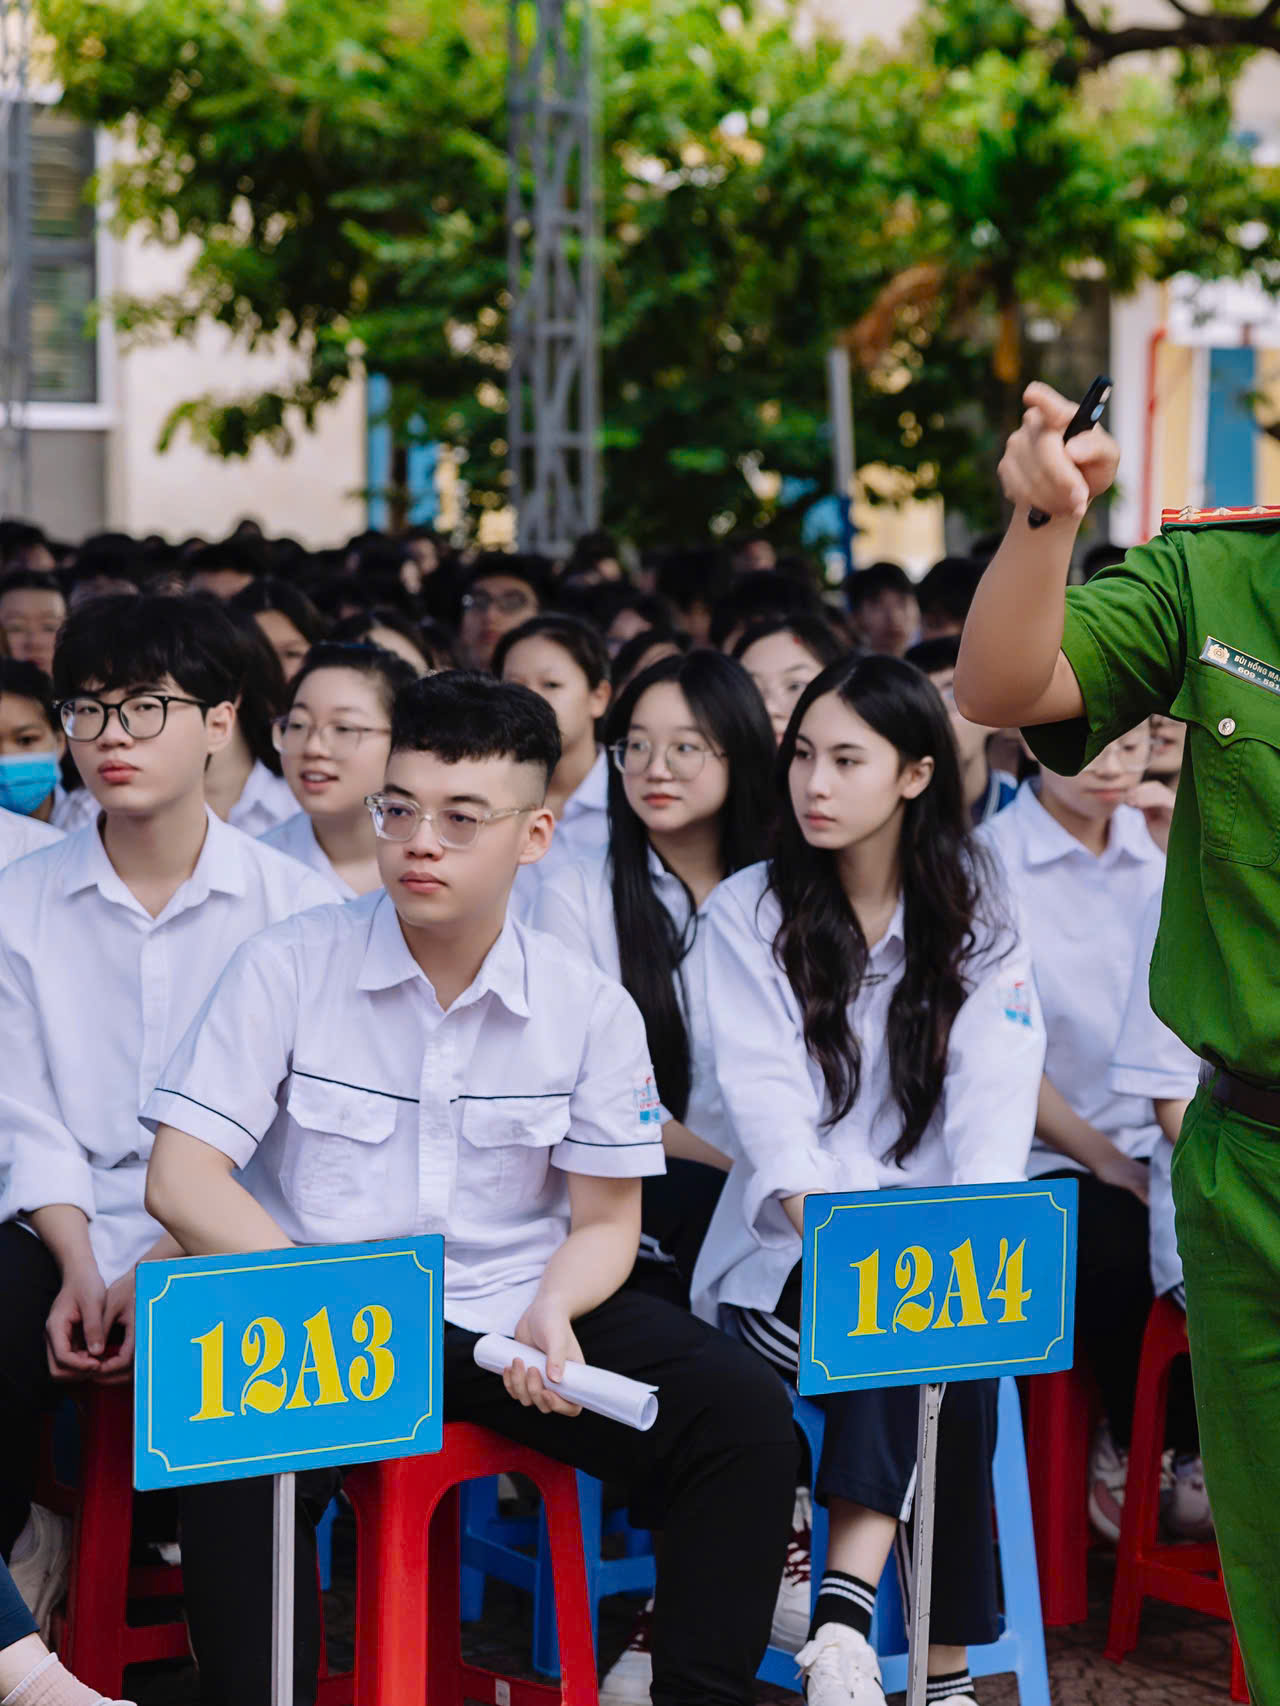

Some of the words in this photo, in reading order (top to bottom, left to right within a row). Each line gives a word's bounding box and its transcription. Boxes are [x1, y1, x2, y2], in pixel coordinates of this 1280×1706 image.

[1234, 654, 1247, 666] BÙI
[1237, 666, 1256, 679] 609
[1263, 678, 1280, 690] 591
[847, 1237, 1032, 1337] 12A4
[189, 1305, 395, 1422] 12A3
